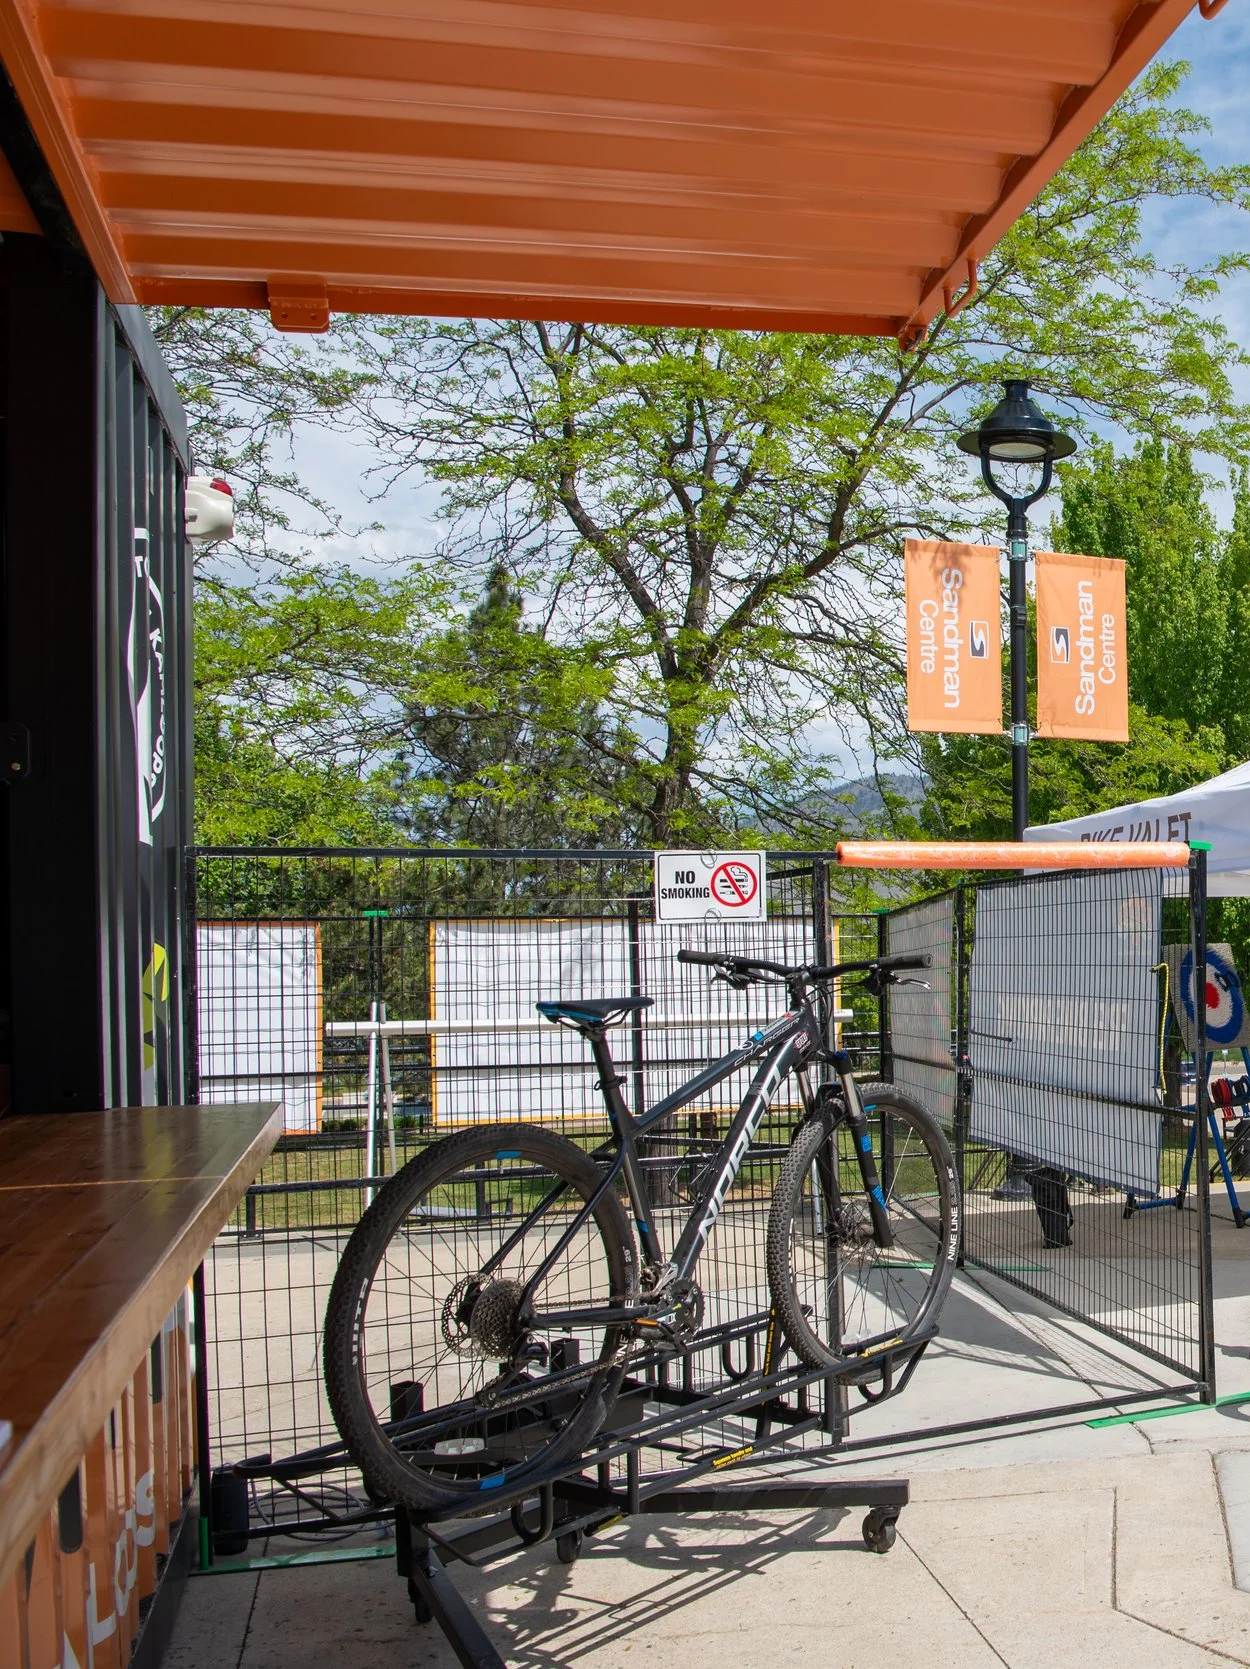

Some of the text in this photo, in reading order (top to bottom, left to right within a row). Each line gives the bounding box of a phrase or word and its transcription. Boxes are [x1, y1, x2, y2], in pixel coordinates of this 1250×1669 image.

[919, 599, 939, 674] Centre
[941, 568, 964, 709] Sandman
[1075, 580, 1094, 715] Sandman
[1099, 613, 1116, 685] Centre
[660, 887, 710, 900] SMOKING
[675, 870, 696, 885] NO
[698, 1064, 781, 1242] NORCO
[947, 1234, 958, 1261] NINE
[951, 1206, 959, 1232] LINE
